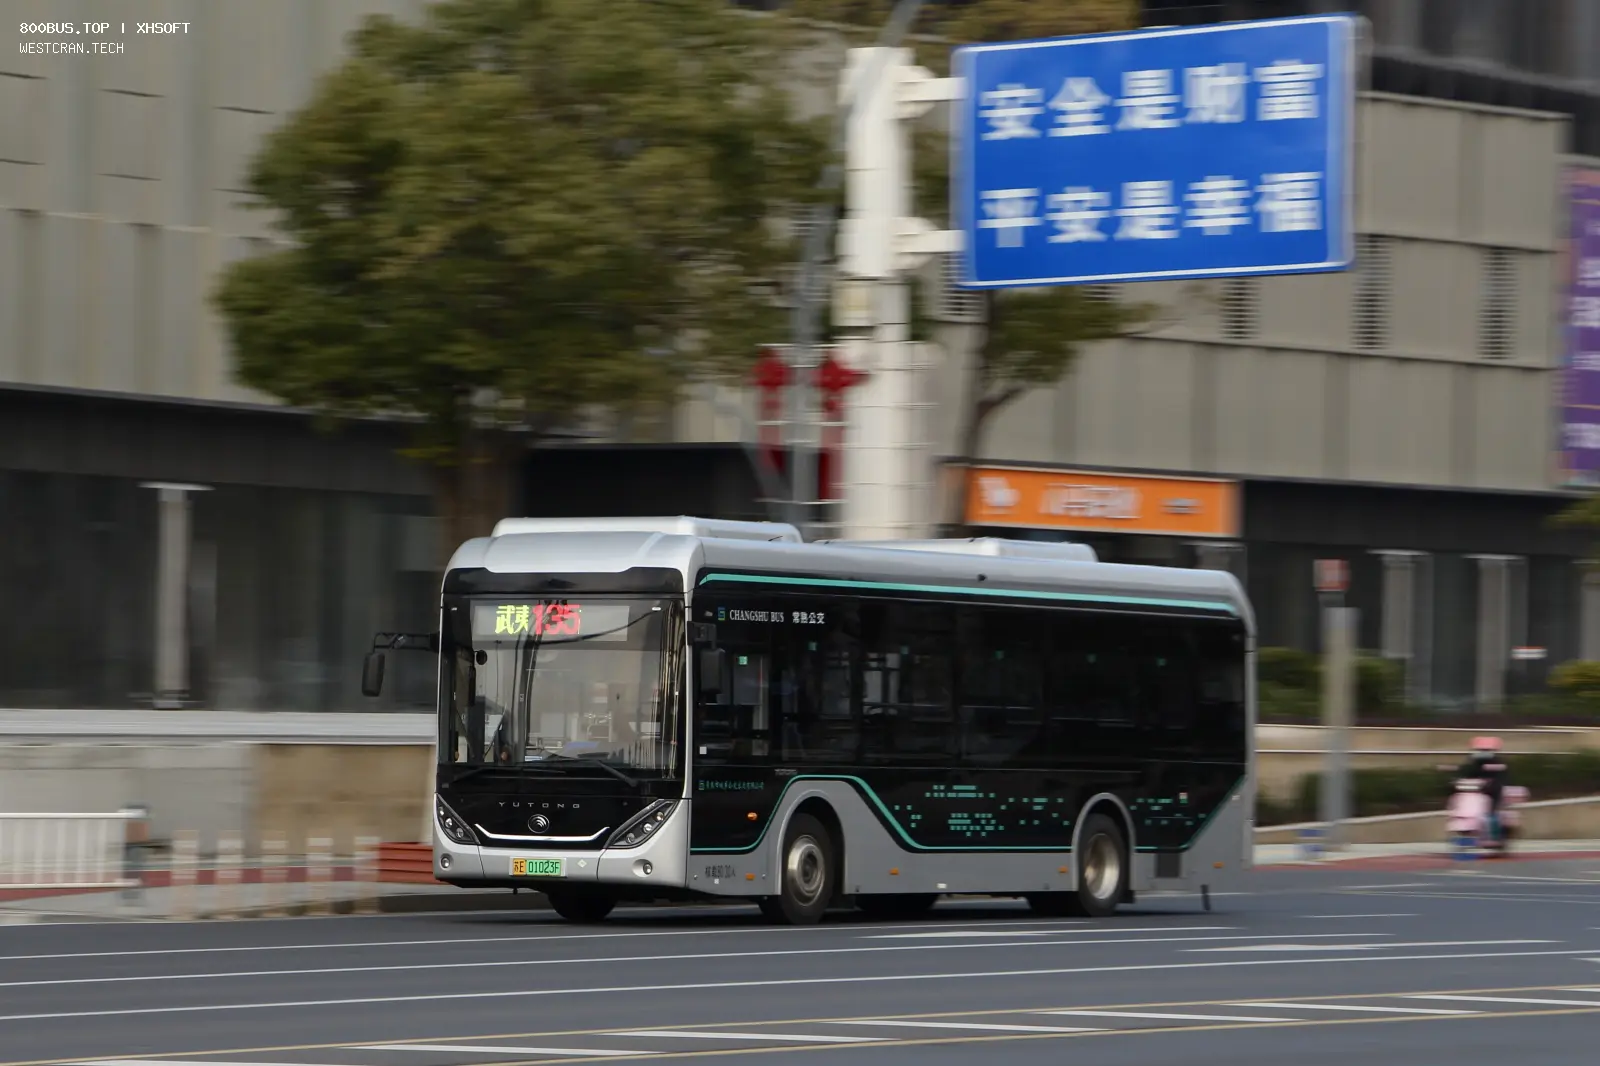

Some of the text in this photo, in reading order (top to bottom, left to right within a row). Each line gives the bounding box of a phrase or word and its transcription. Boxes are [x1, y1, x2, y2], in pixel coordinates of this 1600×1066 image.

[977, 59, 1324, 141] 安全是财富
[977, 171, 1323, 248] 平安是幸福
[729, 609, 825, 625] CHANGSHU BUS 常熟公交
[499, 801, 580, 811] YUTONG
[528, 860, 560, 873] 01023F
